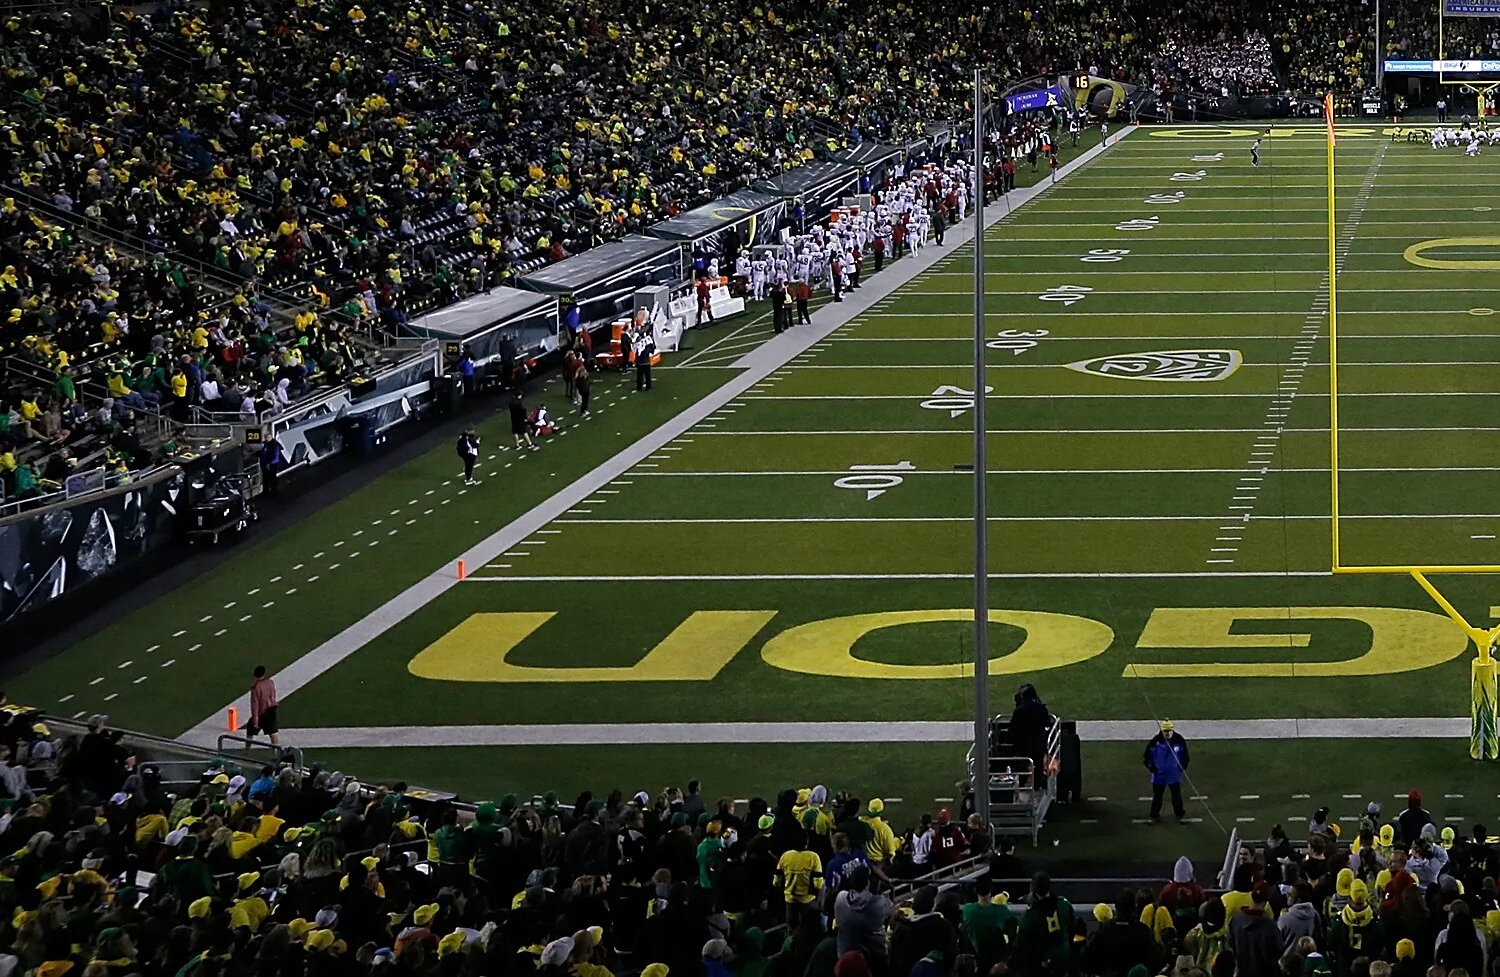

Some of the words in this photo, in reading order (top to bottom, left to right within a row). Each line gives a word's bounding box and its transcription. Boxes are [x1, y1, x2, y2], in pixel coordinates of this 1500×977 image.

[1076, 76, 1088, 88] 16
[1080, 249, 1130, 262] 50
[986, 329, 1049, 349] 30
[920, 385, 994, 409] 20
[834, 461, 916, 489] 10
